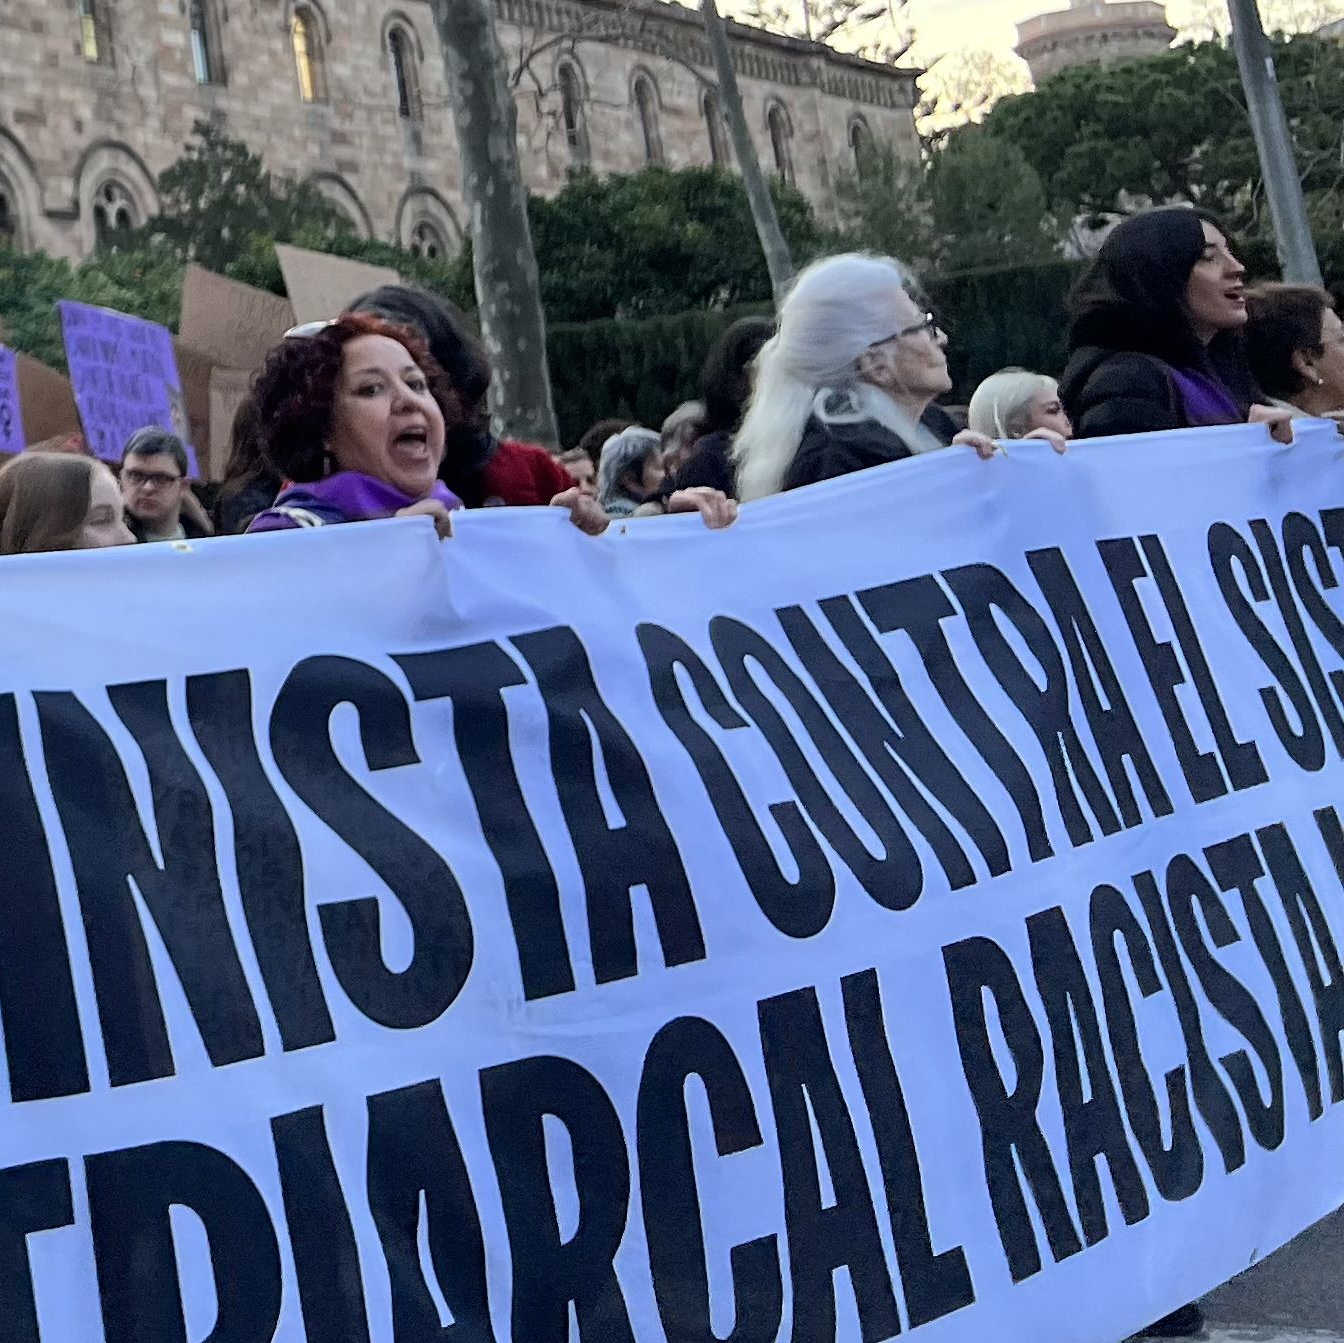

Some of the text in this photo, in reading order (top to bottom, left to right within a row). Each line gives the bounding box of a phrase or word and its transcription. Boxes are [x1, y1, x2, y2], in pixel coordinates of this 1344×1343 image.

[635, 546, 1174, 939] CONTRA
[1095, 533, 1270, 805] EL
[1207, 507, 1344, 772] SIS
